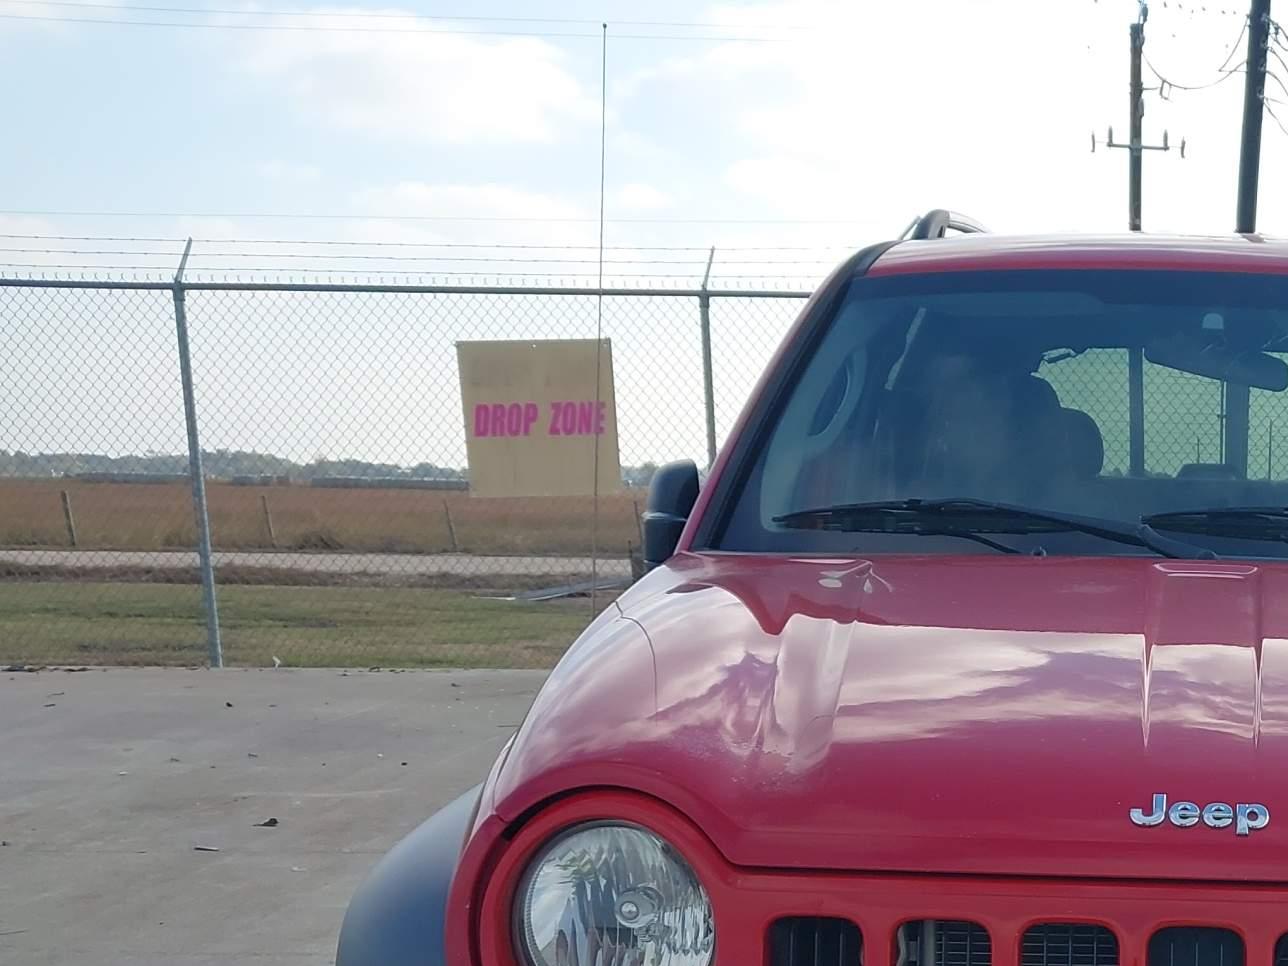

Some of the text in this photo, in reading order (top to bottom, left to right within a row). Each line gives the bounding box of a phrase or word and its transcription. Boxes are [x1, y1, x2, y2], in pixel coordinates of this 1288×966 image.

[474, 401, 607, 437] DROP ZONE
[1129, 793, 1270, 836] Jeep
